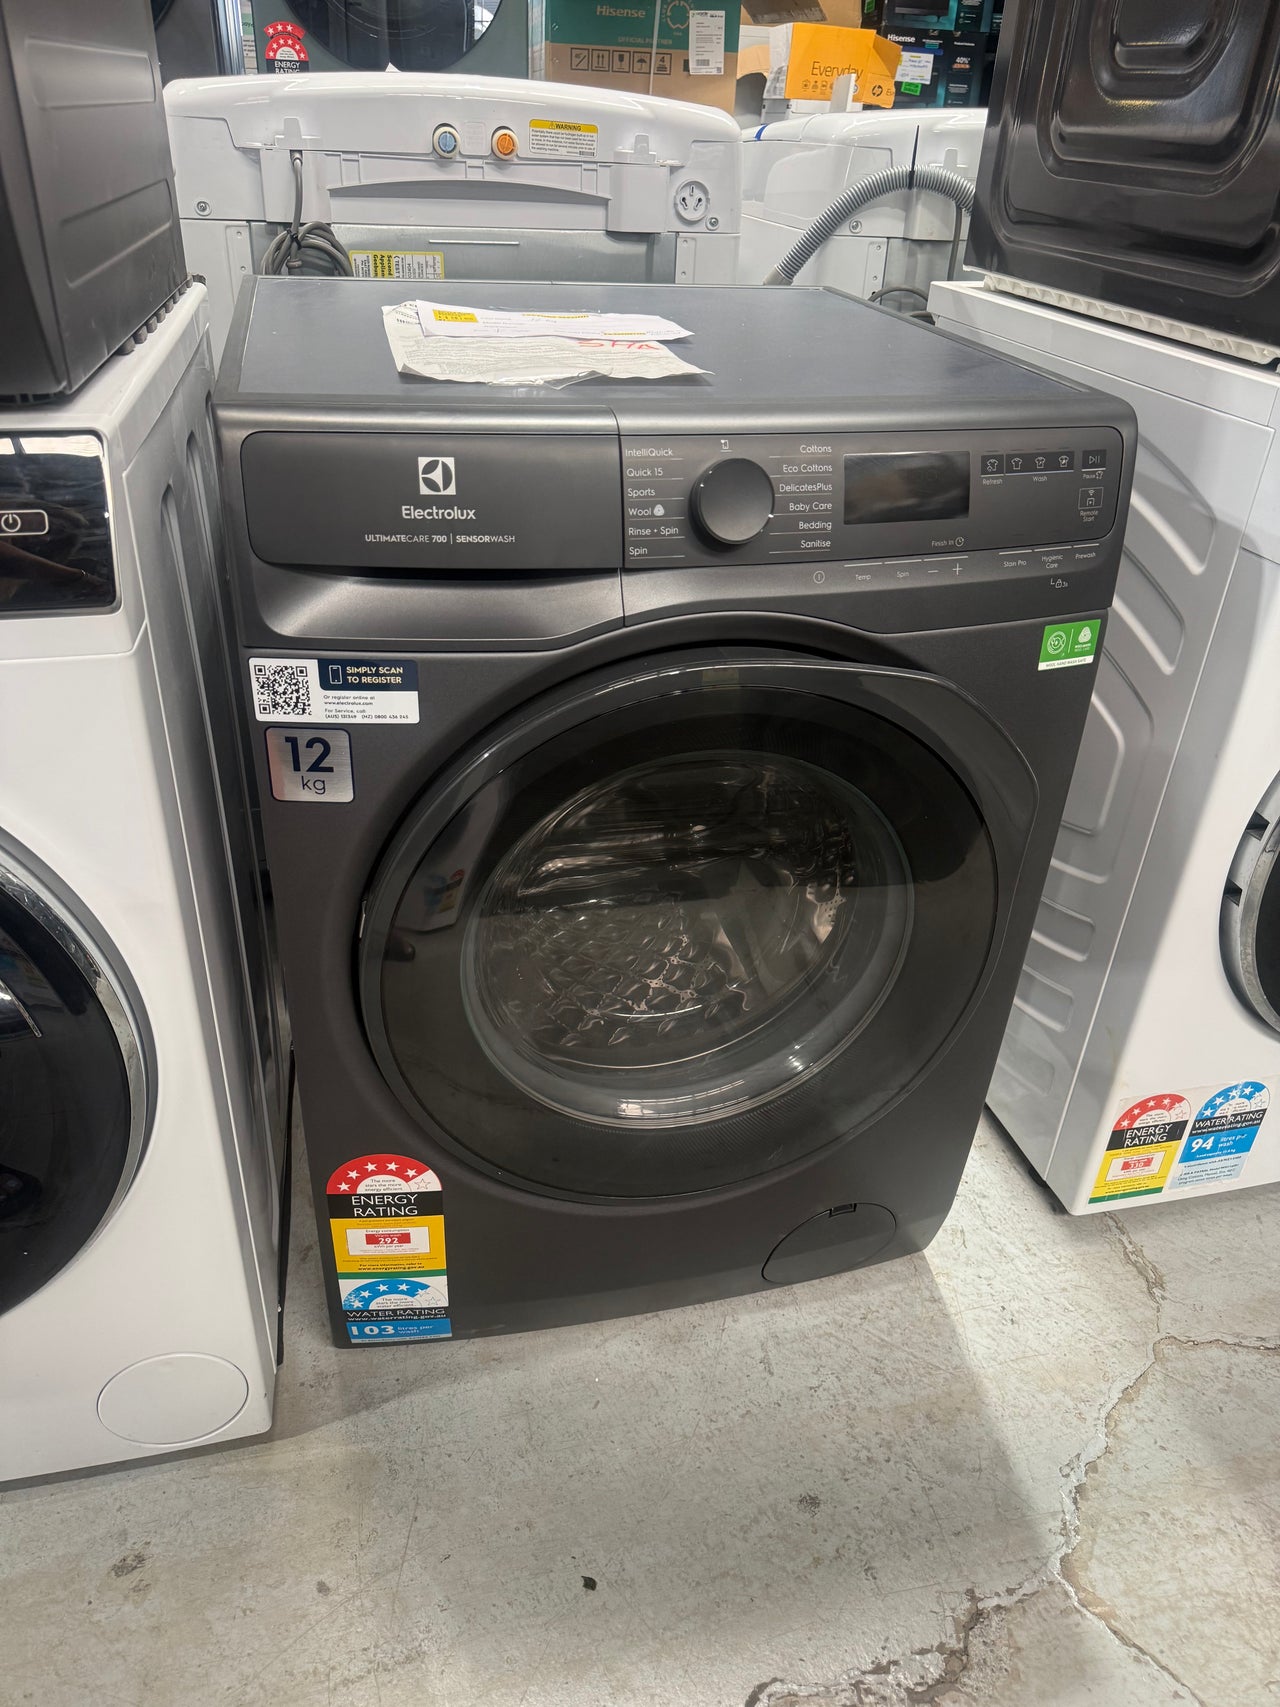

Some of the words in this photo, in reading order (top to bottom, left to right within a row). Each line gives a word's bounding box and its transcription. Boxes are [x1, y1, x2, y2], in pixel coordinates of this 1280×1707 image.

[596, 5, 646, 18] Hisense
[887, 33, 916, 43] Hisense
[555, 122, 581, 131] WARNING
[625, 448, 673, 457] IntelliQuick
[800, 444, 832, 453] Cottons
[626, 468, 647, 478] Quick
[651, 468, 663, 477] 15
[783, 464, 799, 473] Eco
[800, 463, 833, 473] Cottons
[982, 478, 1003, 486] Refresh
[779, 483, 833, 492] DelicatesPlus
[627, 488, 656, 498] Sports
[401, 505, 477, 520] Electrolux
[628, 507, 652, 516] Wool
[789, 503, 810, 513] Baby
[812, 502, 832, 510] Care
[628, 527, 652, 536] Rinse
[660, 526, 679, 536] Spin
[798, 521, 832, 531] Bedding
[365, 534, 430, 543] ULTIMATECARE
[431, 534, 448, 543] 700
[456, 535, 516, 543] SENSORWASH
[800, 540, 831, 548] Sanitise
[629, 546, 648, 556] Spin
[1075, 552, 1097, 560] Prewash
[346, 666, 376, 674] SIMPLY
[378, 666, 403, 674] SCAN
[346, 676, 360, 684] TO
[361, 676, 402, 684] REGISTER
[284, 736, 334, 773] 12
[301, 775, 326, 795] kg
[1195, 1116, 1227, 1128] WATER
[1228, 1111, 1264, 1124] RATING
[1126, 1124, 1173, 1139] ENERGY
[1123, 1133, 1168, 1148] RATING
[1191, 1136, 1215, 1153] 94
[351, 1194, 418, 1206] ENERGY
[353, 1206, 418, 1217] RATING
[378, 1237, 399, 1245] 292
[397, 1308, 445, 1316] RATING
[350, 1325, 396, 1336] 103
